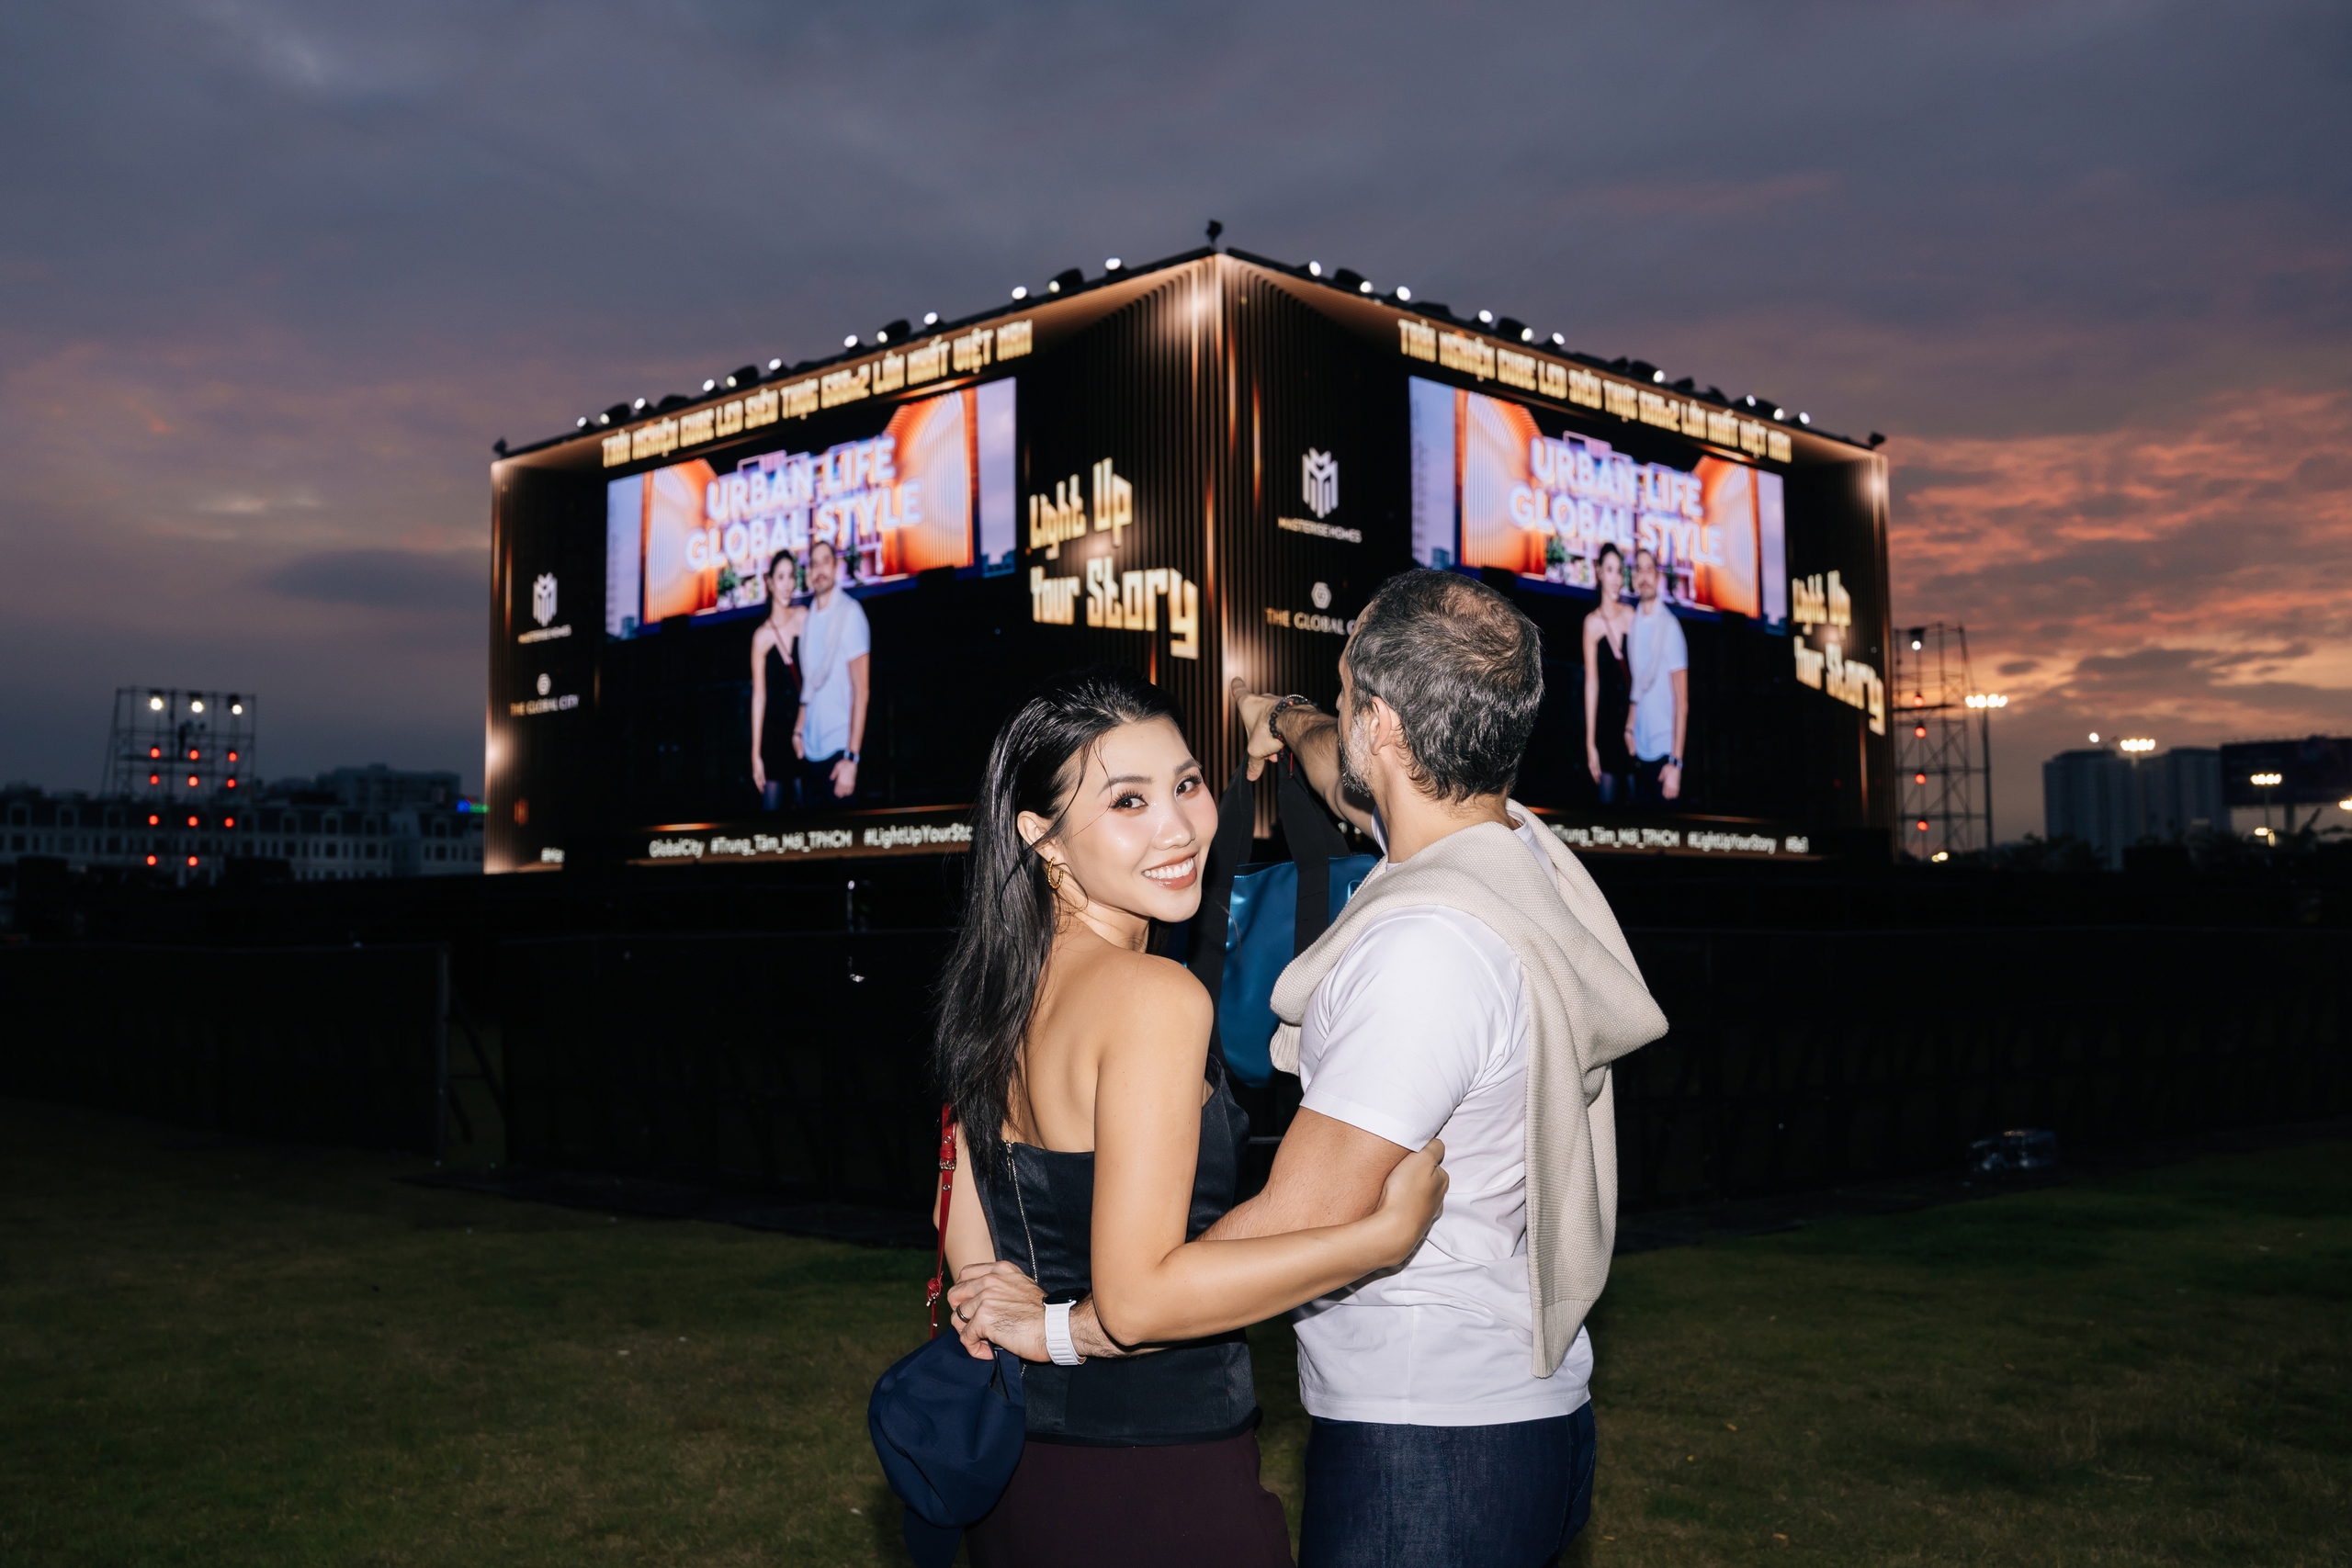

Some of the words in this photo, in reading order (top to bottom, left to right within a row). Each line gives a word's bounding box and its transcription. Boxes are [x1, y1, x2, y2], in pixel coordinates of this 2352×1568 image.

[707, 462, 815, 521] URBAN
[826, 436, 897, 492] LIFE
[1029, 473, 1087, 560] Light
[1092, 457, 1133, 547] Up
[1531, 436, 1637, 505] URBAN
[1645, 467, 1703, 517] LIFE
[685, 508, 808, 570] GLOBAL
[817, 479, 922, 548] STYLE
[1510, 484, 1633, 545] GLOBAL
[1640, 513, 1724, 568] STYLE
[1030, 566, 1080, 626] Your
[1087, 556, 1199, 660] Story
[1264, 607, 1291, 628] THE
[1294, 612, 1346, 636] GLOBAL
